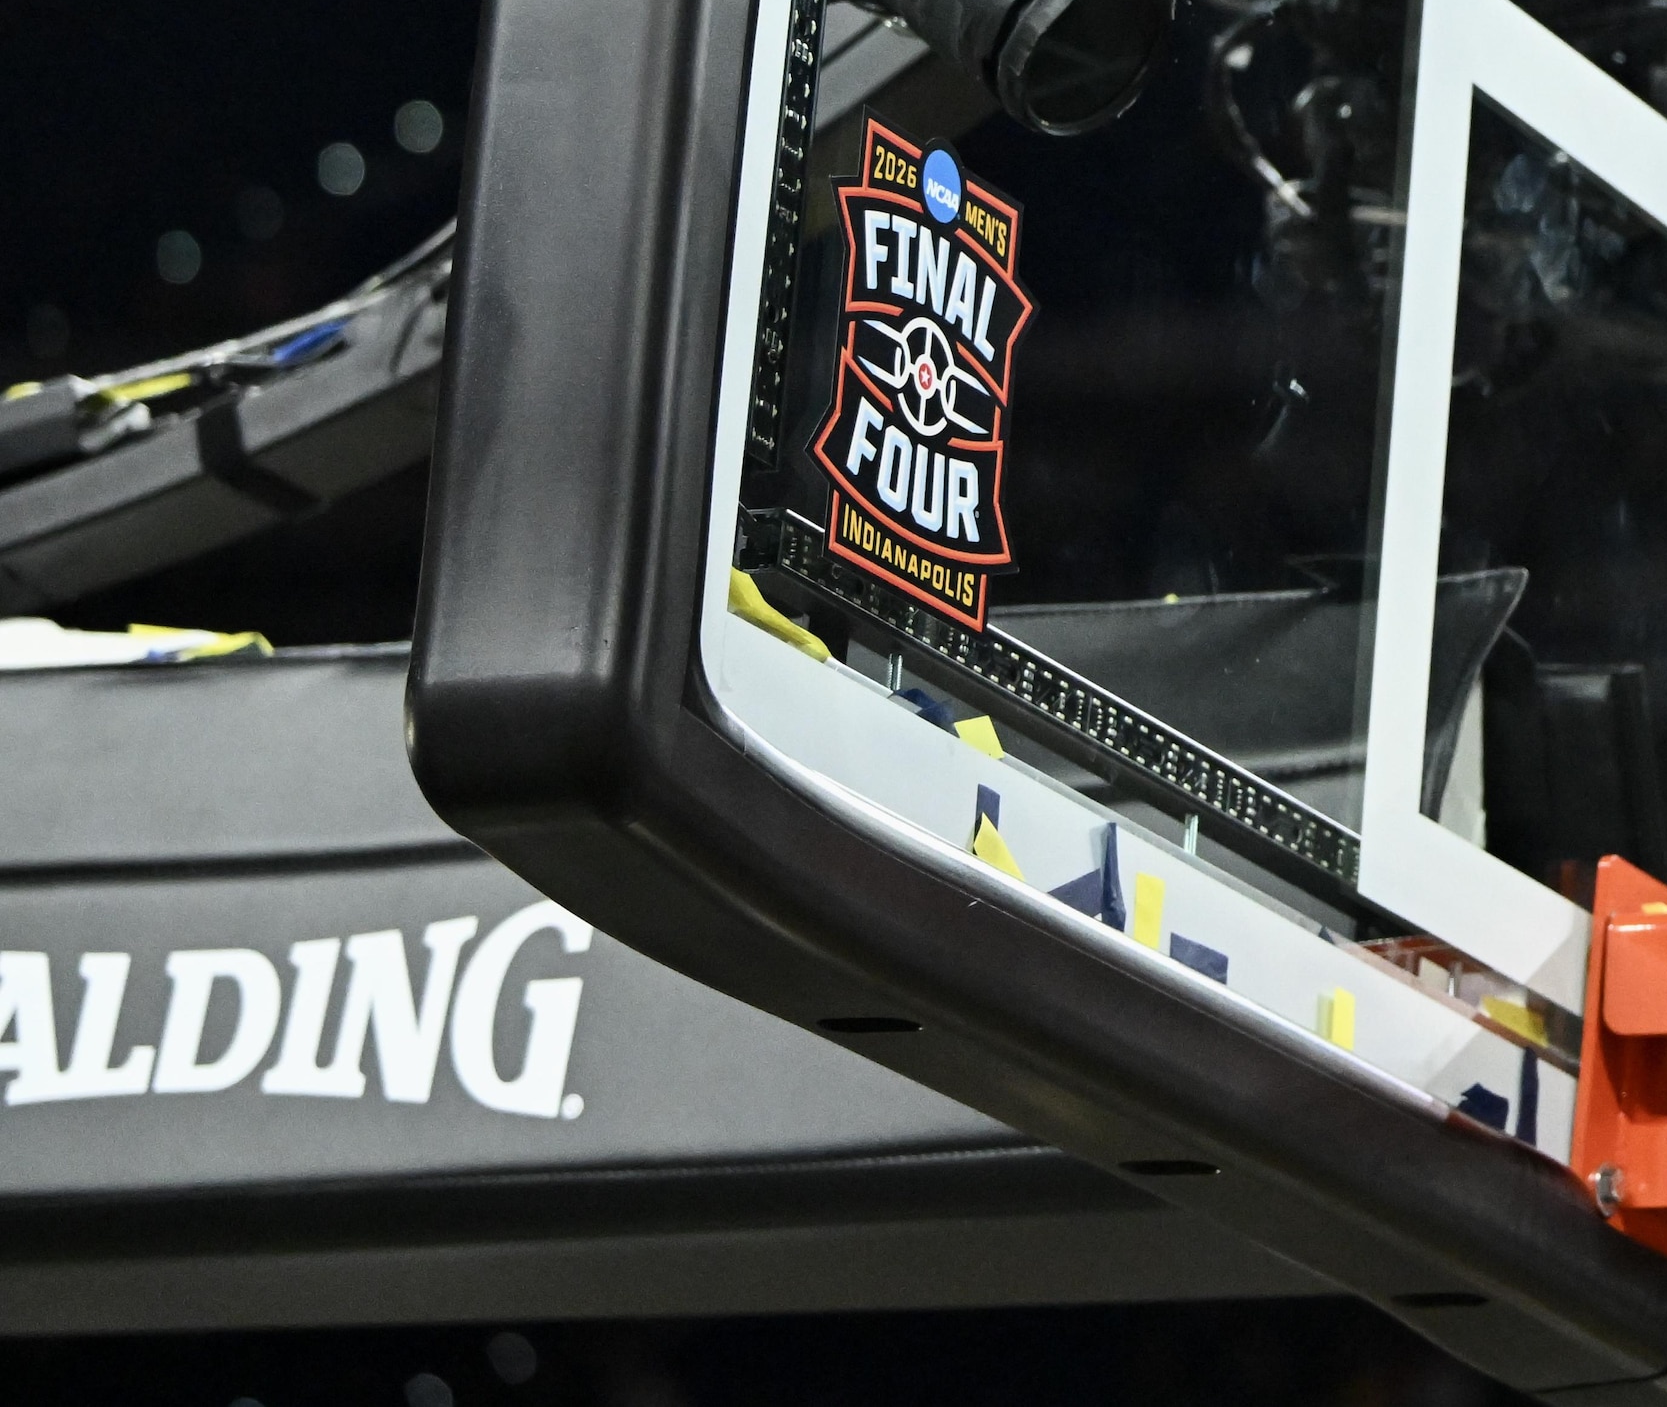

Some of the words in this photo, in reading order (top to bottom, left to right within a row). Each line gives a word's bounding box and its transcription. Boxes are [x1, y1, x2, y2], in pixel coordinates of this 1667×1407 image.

[873, 145, 917, 189] 2026
[925, 177, 961, 214] NCAA
[964, 200, 1008, 258] MEN'S
[864, 209, 997, 362] FINAL
[845, 396, 980, 543] FOUR
[842, 502, 976, 607] INDIANAPOLIS
